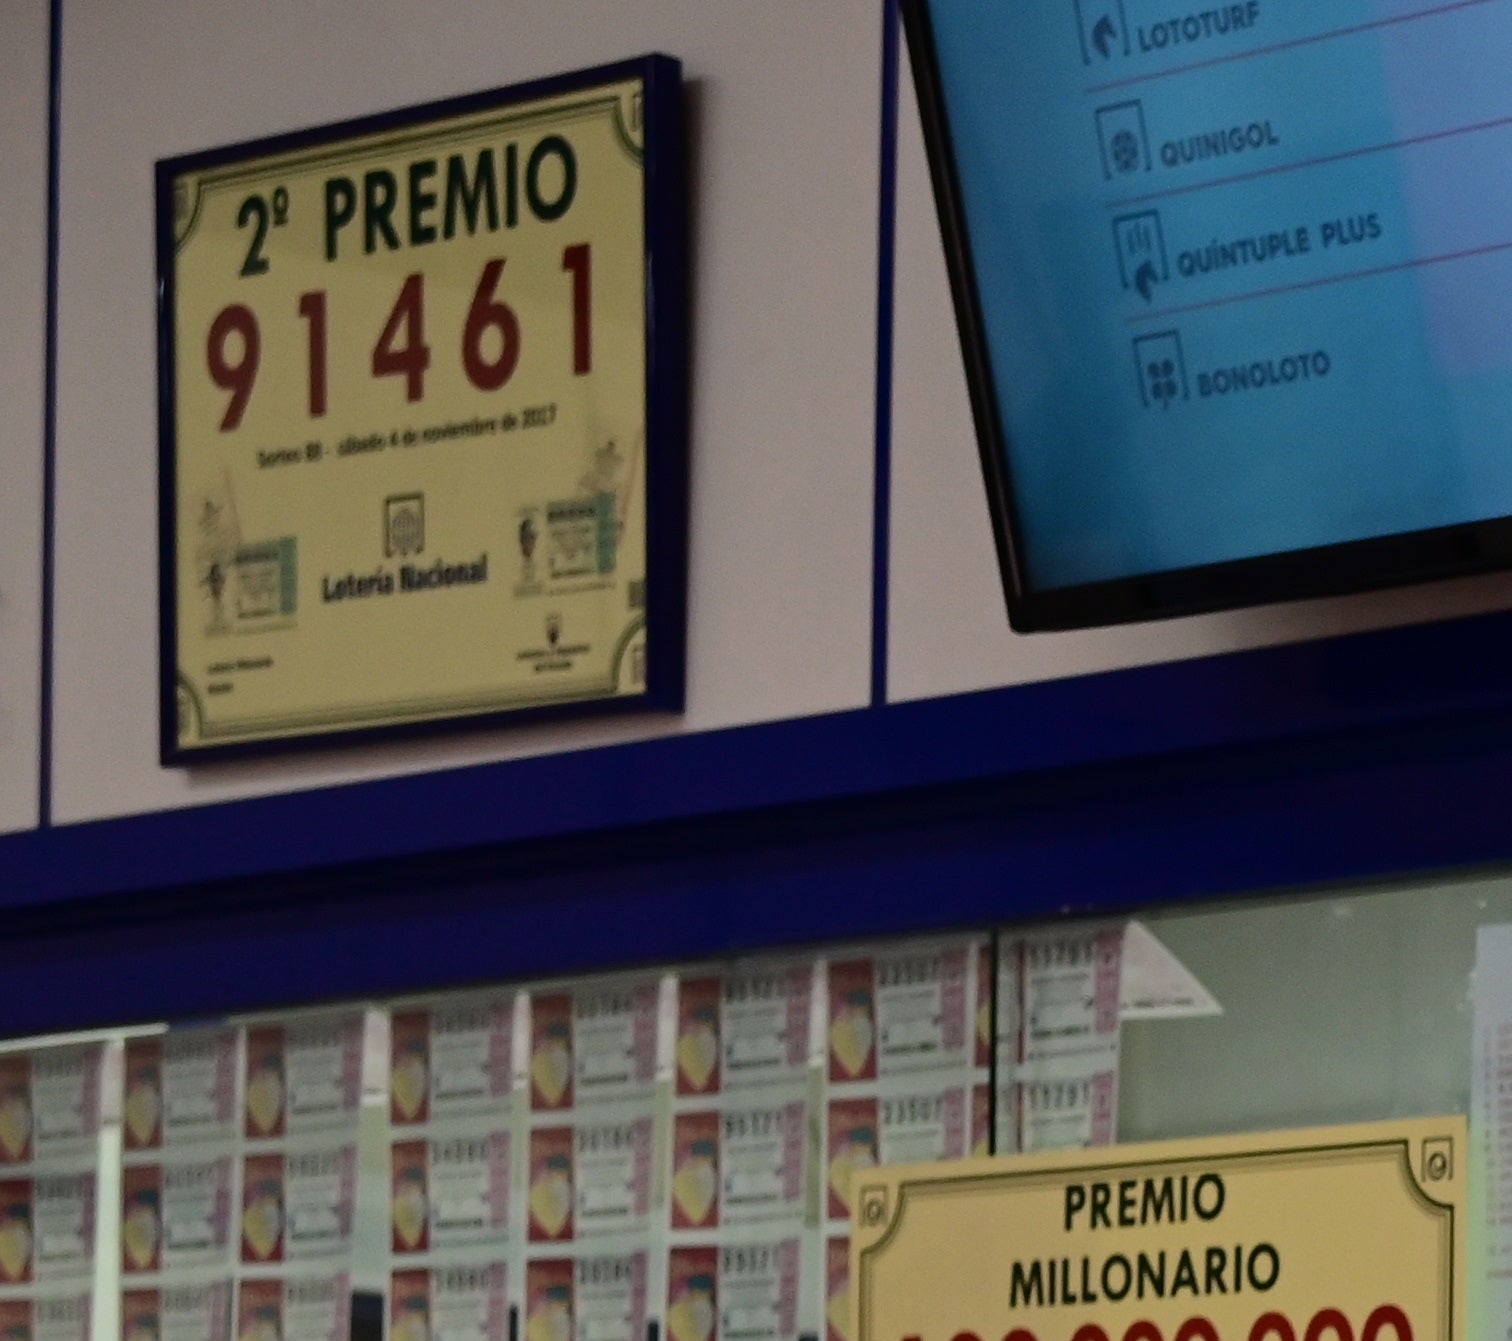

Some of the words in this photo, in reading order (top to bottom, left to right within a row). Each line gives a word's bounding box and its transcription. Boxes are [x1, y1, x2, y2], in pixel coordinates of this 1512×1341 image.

[1139, 1, 1261, 53] LOTOTURF
[1161, 120, 1280, 167] QUINIGOL
[237, 186, 290, 277] 2º
[324, 134, 578, 262] PREMIO
[1321, 214, 1382, 250] PLUS
[207, 243, 592, 432] 91461
[1199, 350, 1331, 396] BONOLOTO
[400, 553, 489, 594] Nacional
[1064, 1172, 1226, 1232] PREMIO
[1008, 1243, 1280, 1309] MILLONARIO
